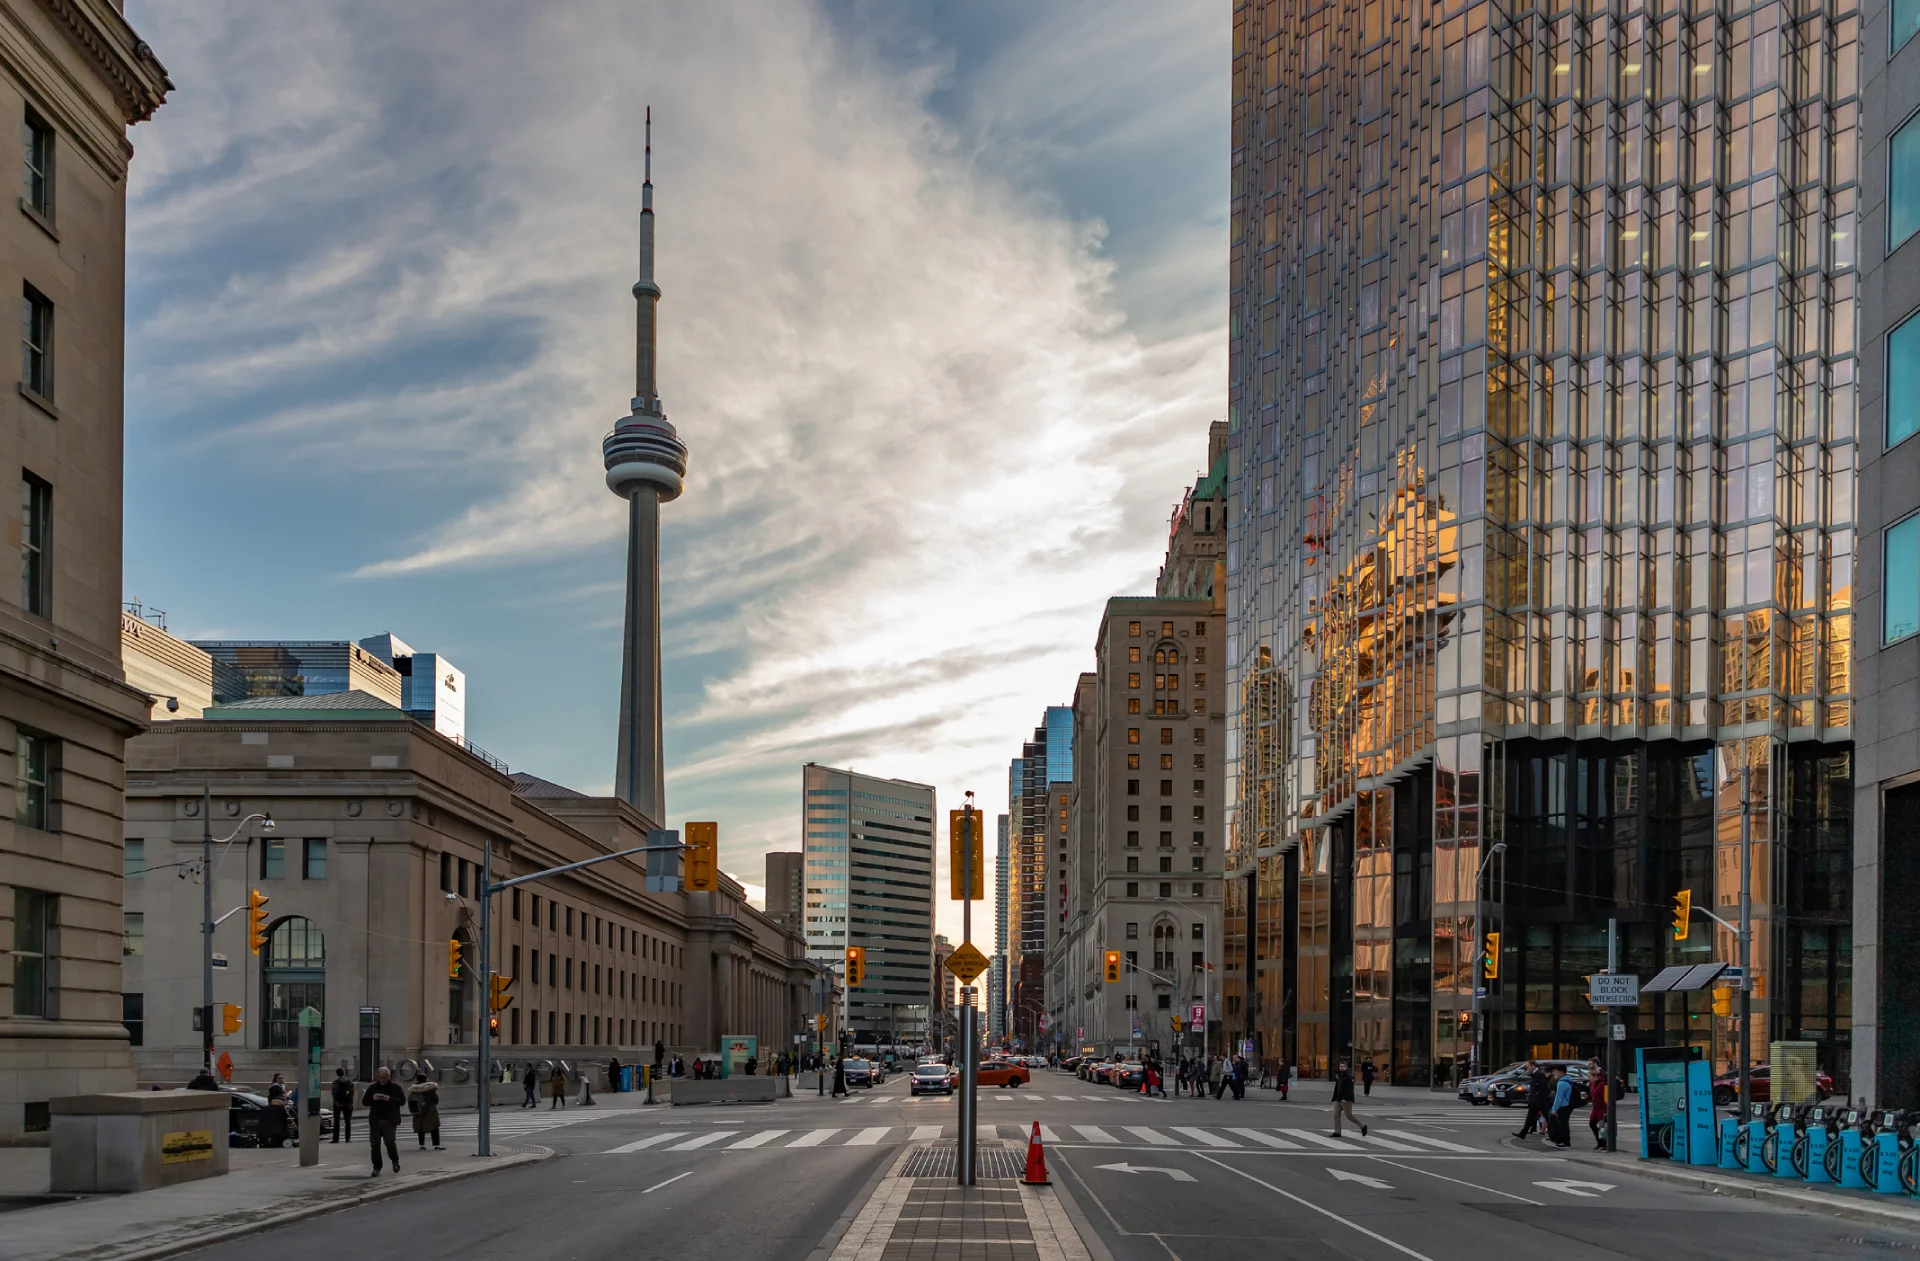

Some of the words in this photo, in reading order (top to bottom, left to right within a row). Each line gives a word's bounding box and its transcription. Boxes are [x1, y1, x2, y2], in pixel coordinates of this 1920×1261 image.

[1196, 1008, 1202, 1016] 9
[341, 1057, 441, 1083] UON
[452, 1059, 578, 1083] STATON
